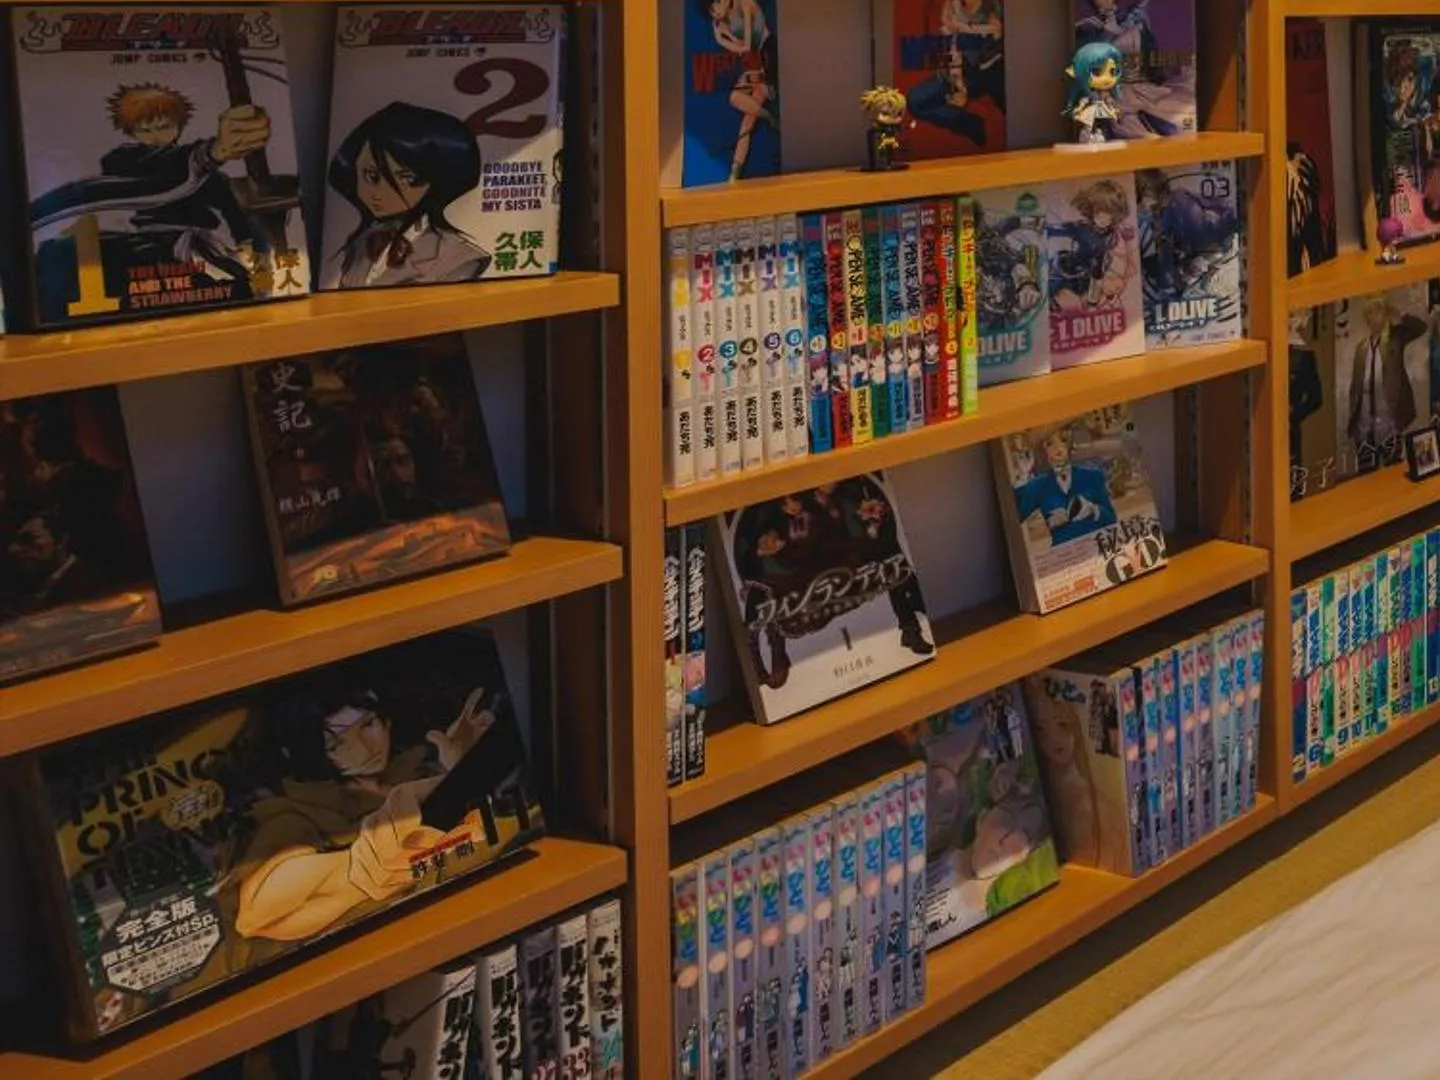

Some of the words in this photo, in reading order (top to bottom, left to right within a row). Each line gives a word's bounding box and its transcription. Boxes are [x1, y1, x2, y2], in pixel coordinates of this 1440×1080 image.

[453, 57, 551, 139] 2
[482, 186, 546, 200] GOODNITE
[1200, 178, 1231, 198] 03
[481, 201, 501, 213] MY
[504, 198, 542, 211] SISTA
